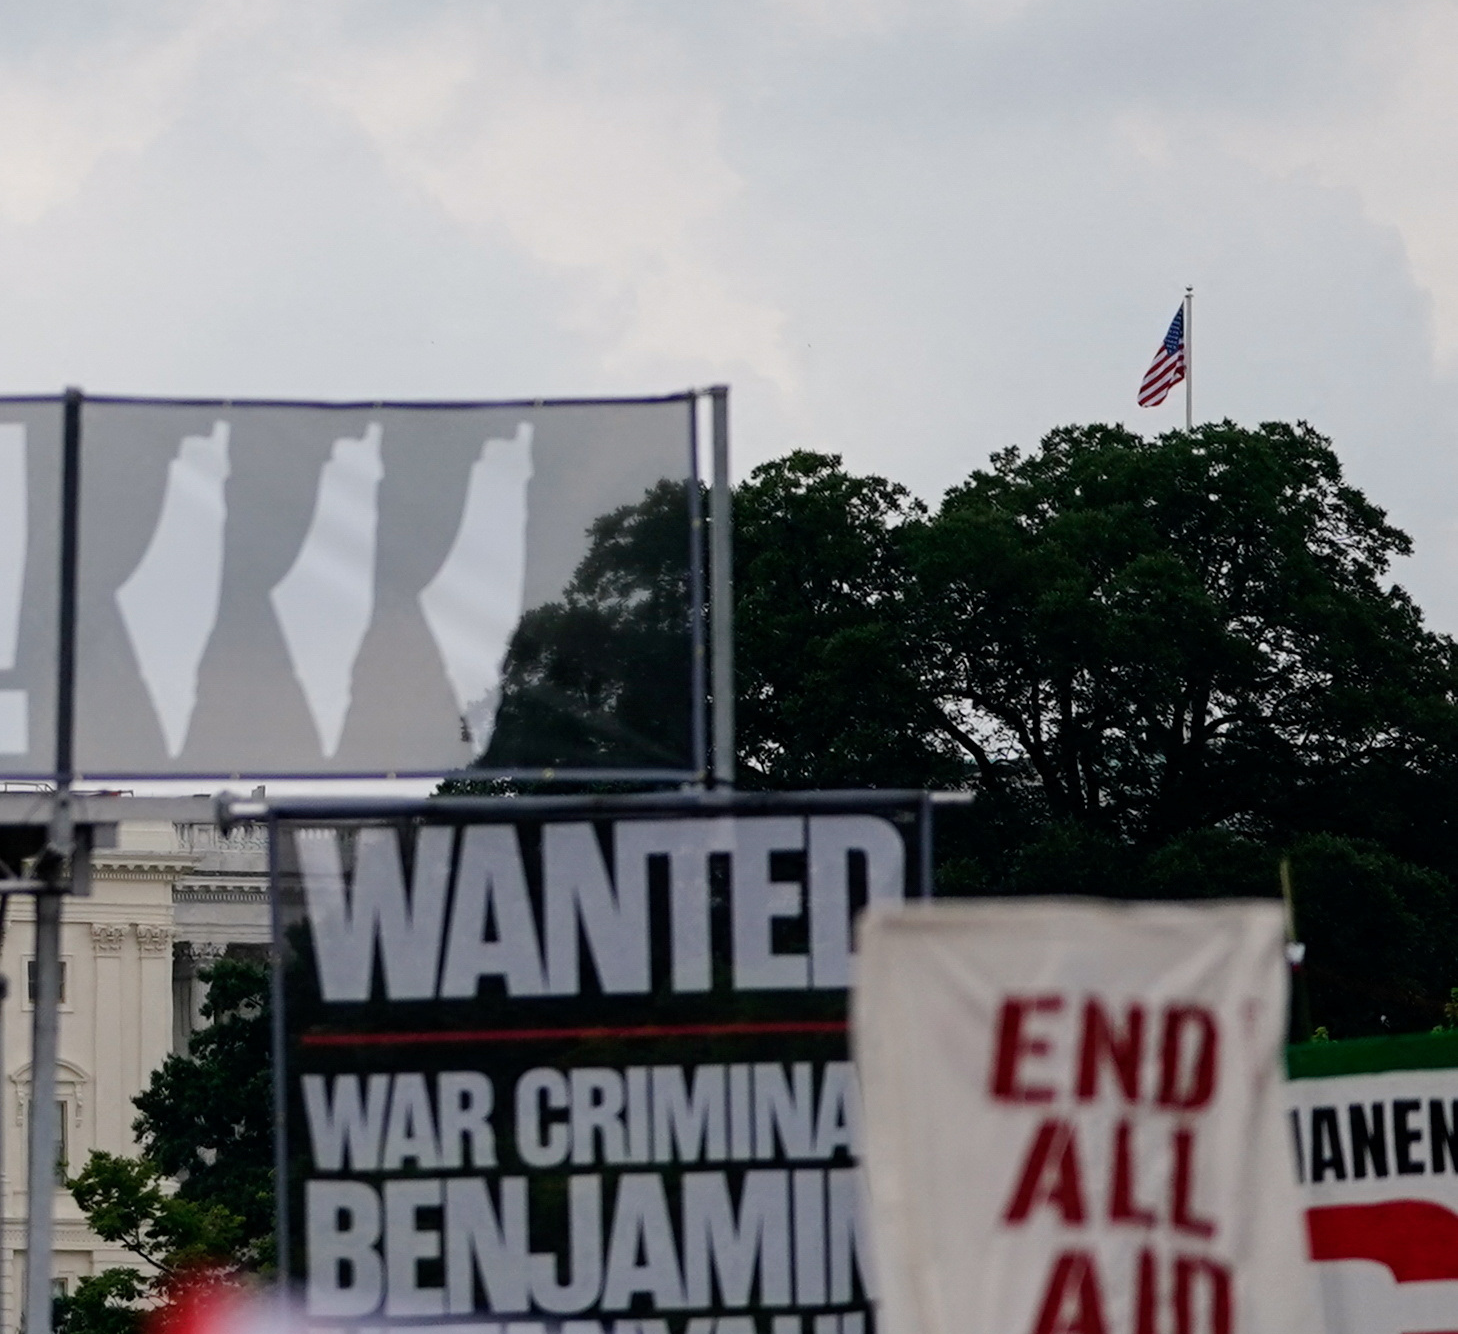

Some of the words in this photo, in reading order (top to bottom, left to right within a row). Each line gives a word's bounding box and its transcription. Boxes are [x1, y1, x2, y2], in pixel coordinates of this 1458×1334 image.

[295, 814, 907, 1003] WANTED
[987, 988, 1222, 1114] END
[300, 1069, 494, 1173] WAR
[514, 1060, 864, 1169] CRIMINA
[1290, 1097, 1458, 1185] ANE
[998, 1117, 1218, 1241] ALL
